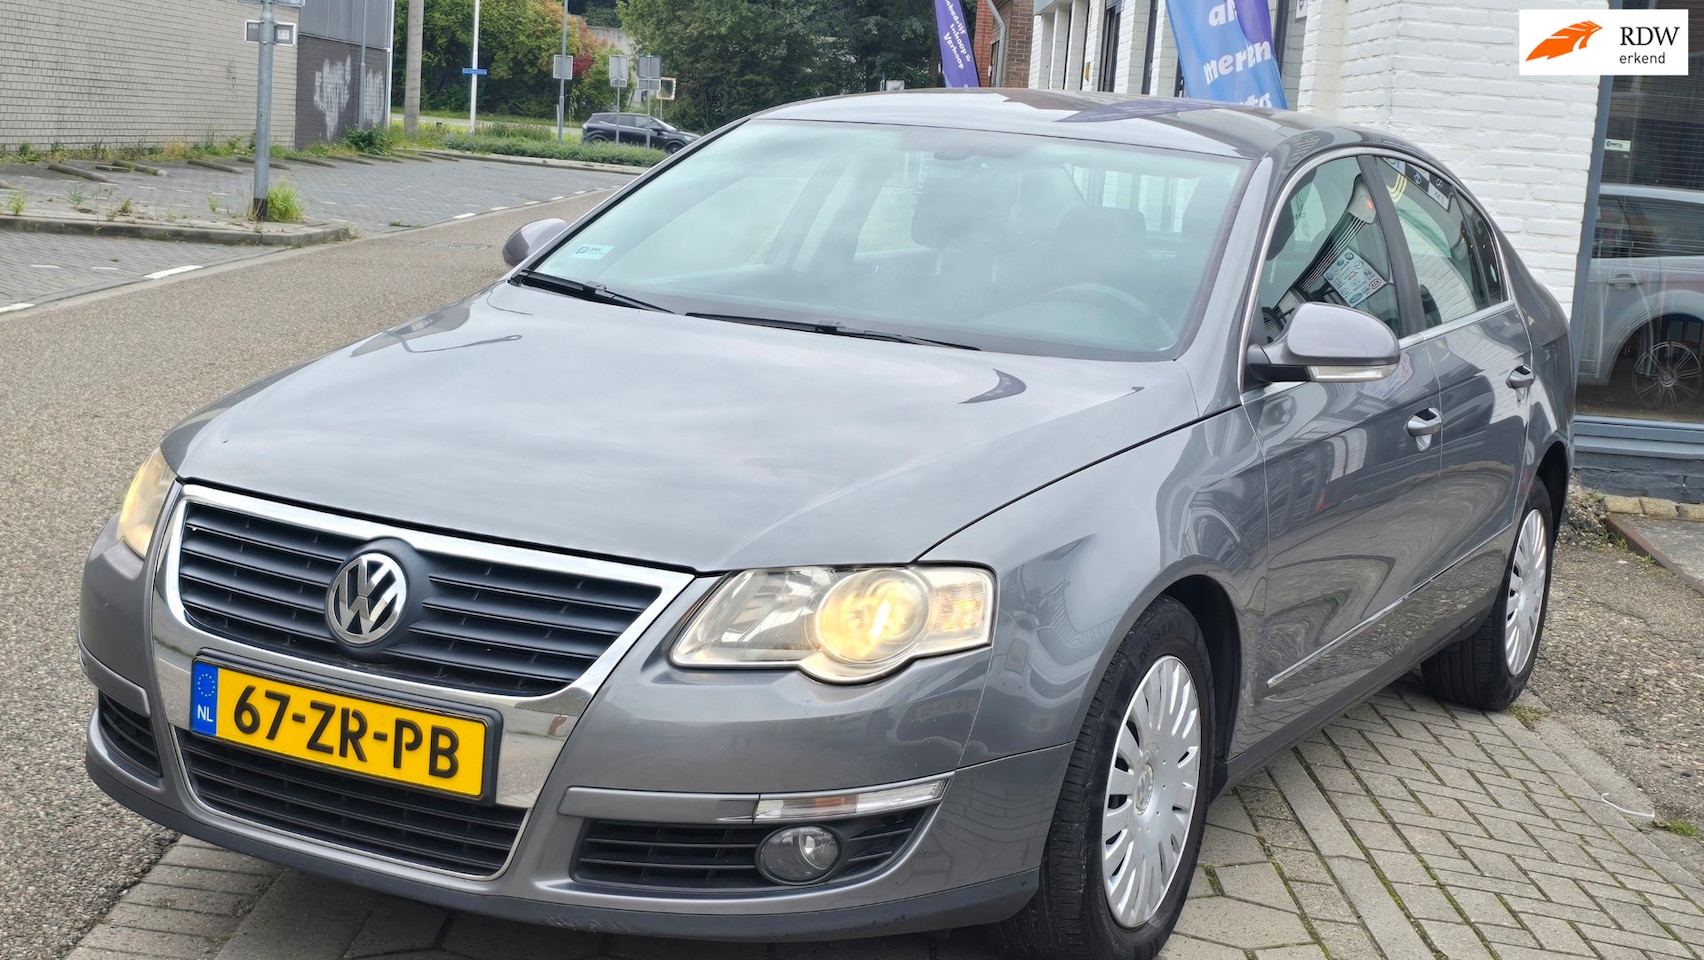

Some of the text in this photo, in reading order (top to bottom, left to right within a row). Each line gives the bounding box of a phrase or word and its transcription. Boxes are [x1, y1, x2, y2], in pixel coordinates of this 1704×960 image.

[1203, 41, 1272, 85] meren
[197, 704, 214, 722] NL
[234, 685, 459, 779] 67-ZR-PB
